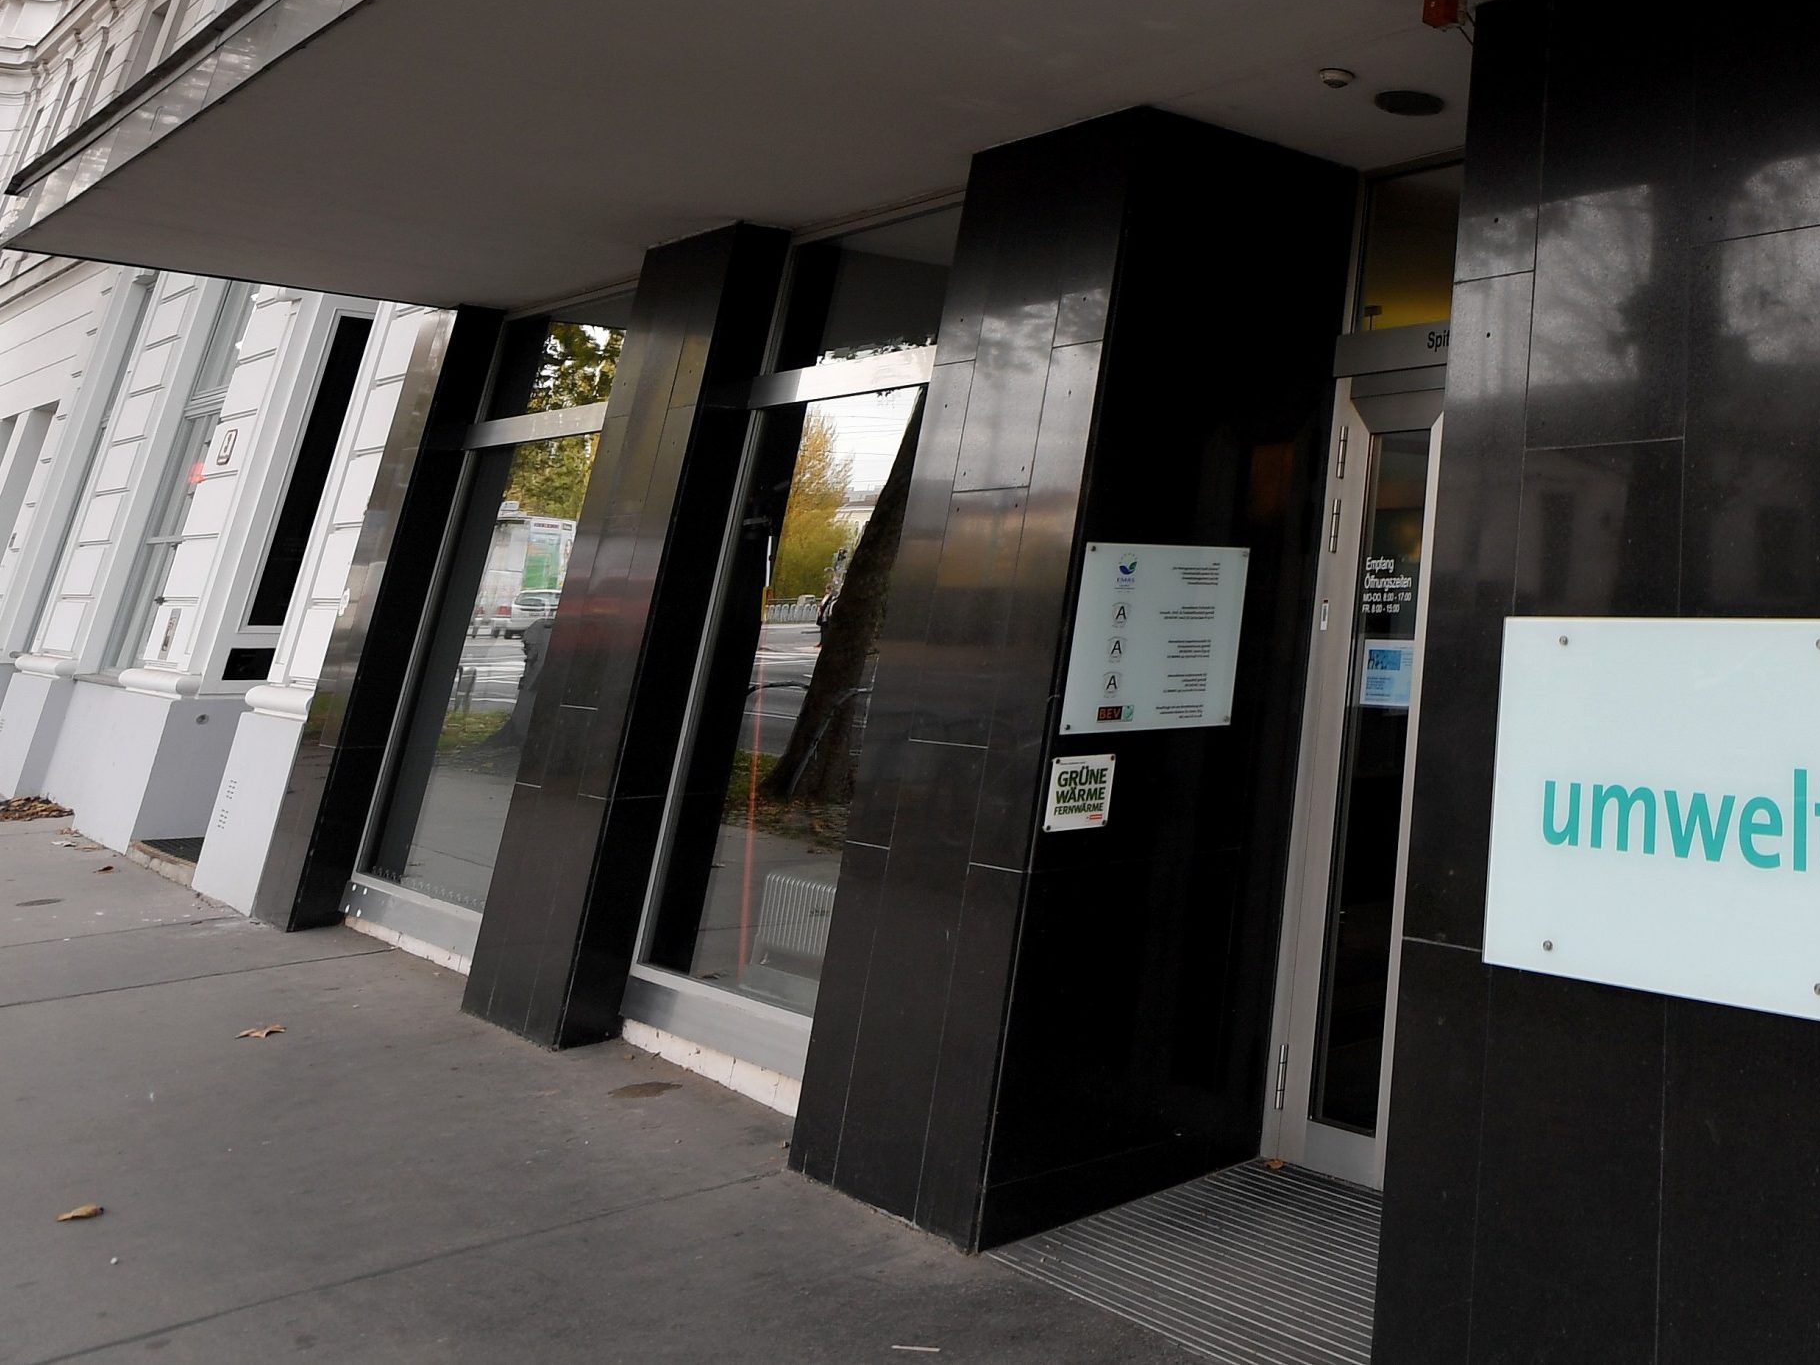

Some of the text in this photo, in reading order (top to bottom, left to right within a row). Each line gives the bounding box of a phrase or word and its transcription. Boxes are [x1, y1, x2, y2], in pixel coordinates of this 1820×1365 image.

[1365, 555, 1395, 573] Empfang
[1363, 572, 1412, 591] Öffnungszeiten
[1115, 605, 1127, 620] A
[1110, 640, 1122, 655] A
[1106, 675, 1118, 690] A
[1099, 707, 1121, 720] BEV
[1057, 765, 1108, 788] GRÜNE
[1056, 786, 1106, 804] WÄRME
[1054, 802, 1104, 816] FERNWÄRME
